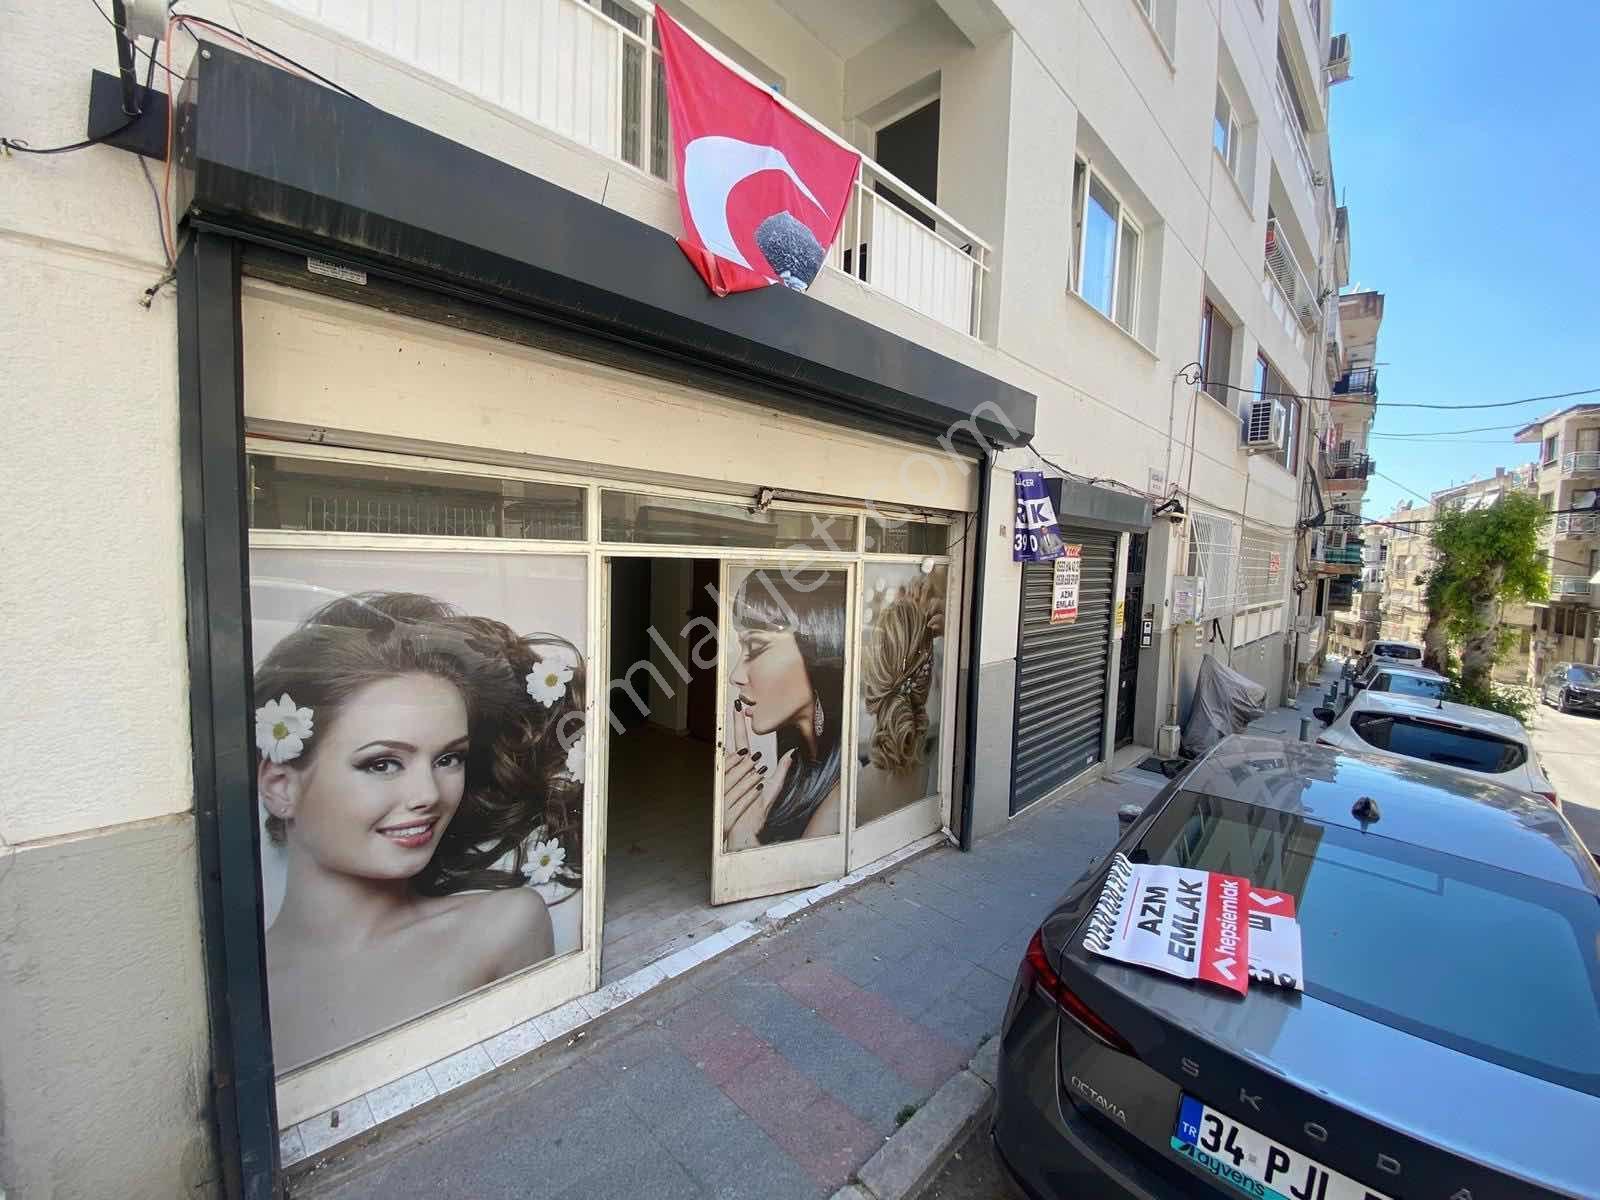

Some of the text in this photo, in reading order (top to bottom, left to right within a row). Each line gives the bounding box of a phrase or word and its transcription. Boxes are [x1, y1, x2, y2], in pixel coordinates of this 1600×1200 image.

[1056, 600, 1075, 609] EMLAK
[1060, 591, 1073, 599] AZM
[1137, 885, 1169, 936] AZM
[1167, 877, 1203, 963] EMLAK
[1213, 879, 1240, 959] hepsiemlak
[1071, 1075, 1128, 1126] OCTAVIA
[1183, 1121, 1197, 1138] TR
[1200, 1113, 1245, 1167] 34
[1197, 1151, 1265, 1196] ayvens
